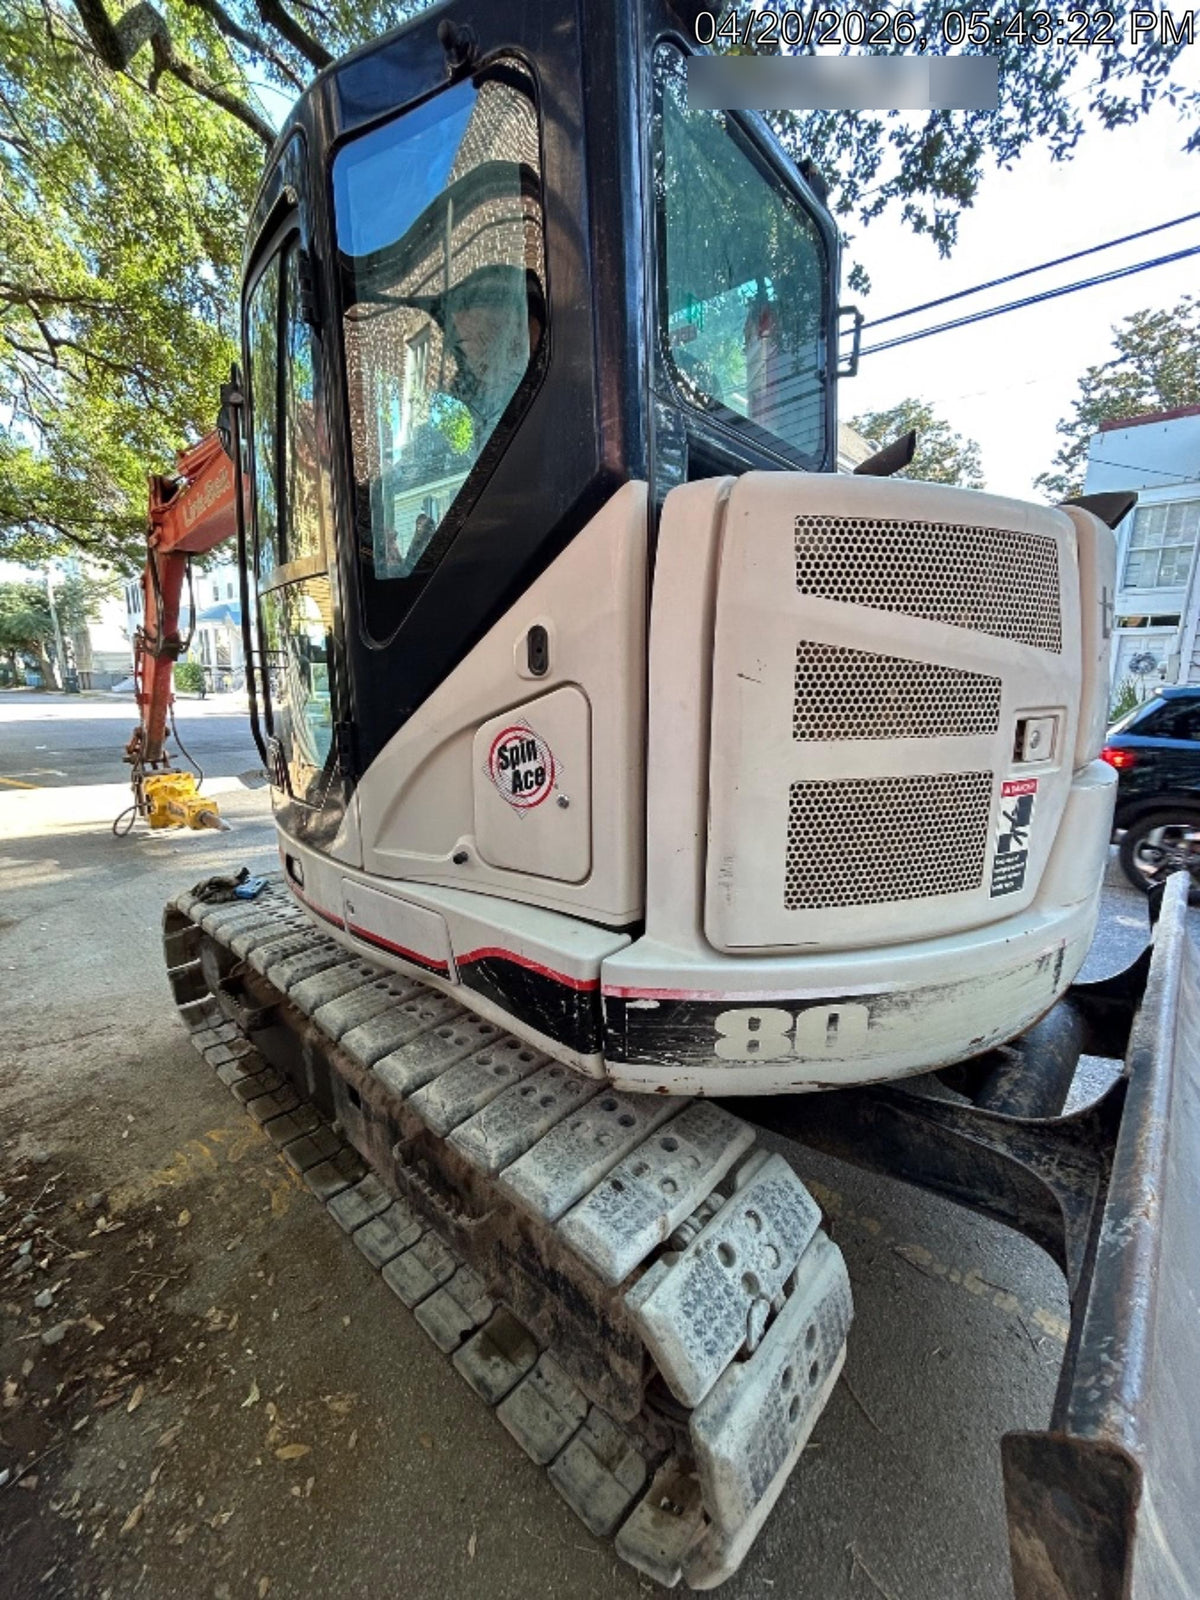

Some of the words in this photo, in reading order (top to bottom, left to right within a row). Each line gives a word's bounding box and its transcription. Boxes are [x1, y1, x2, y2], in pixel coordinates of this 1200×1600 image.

[498, 738, 537, 770] Spin
[512, 766, 546, 795] Ace
[714, 1004, 869, 1061] 80
